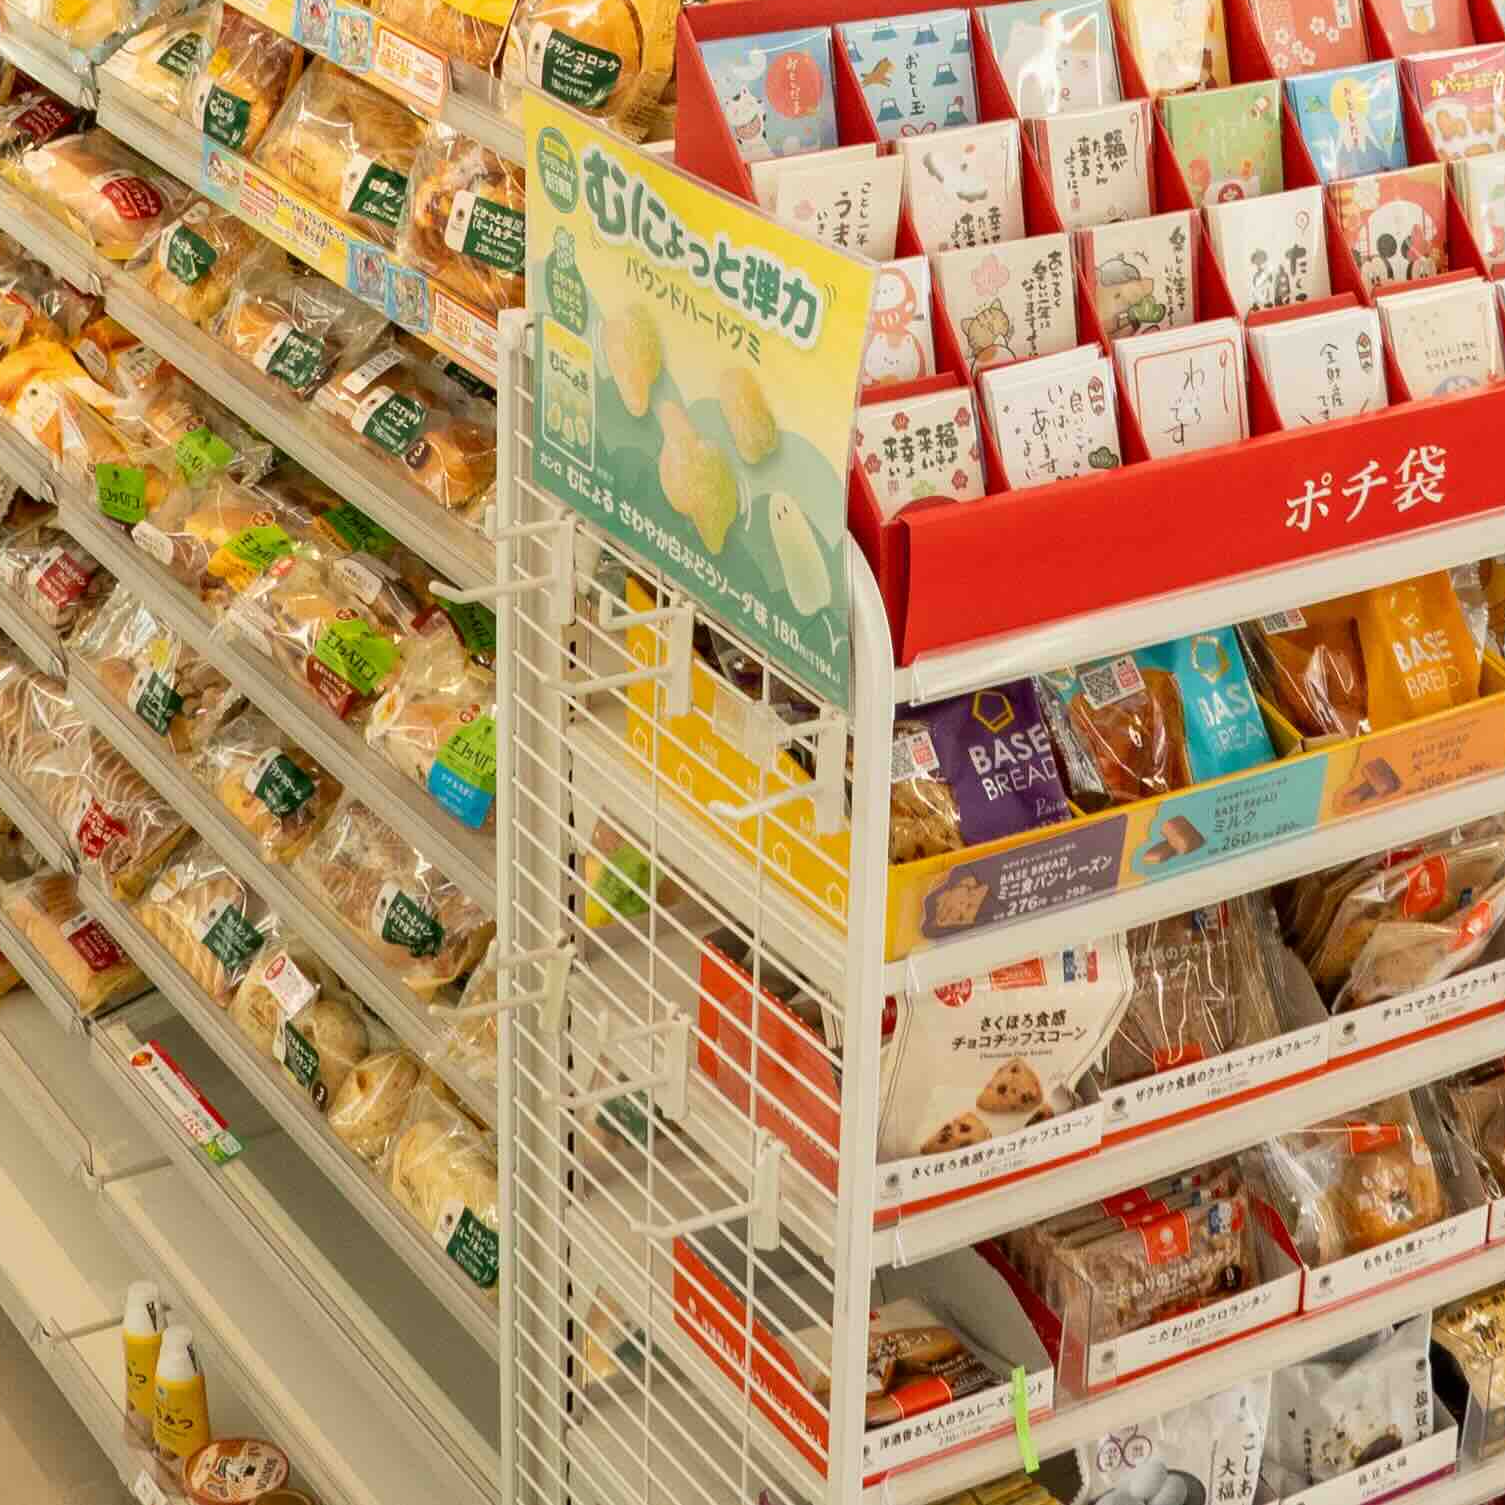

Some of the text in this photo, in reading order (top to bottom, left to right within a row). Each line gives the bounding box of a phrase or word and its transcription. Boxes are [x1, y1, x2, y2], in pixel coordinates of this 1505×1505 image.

[555, 57, 595, 75] バーガー
[904, 51, 927, 115] おとし玉
[583, 150, 817, 338] むにょっと弾力
[567, 468, 614, 513] むにょる
[1285, 445, 1447, 532] ポチ袋
[1391, 630, 1454, 673] BASE
[1198, 682, 1250, 727] BAS
[968, 726, 1051, 773] BASE
[1215, 721, 1266, 752] REA
[981, 756, 1060, 801] BREAD
[1213, 812, 1257, 834] ミルク
[951, 1026, 1087, 1052] チョコチップスコーン
[979, 1009, 1068, 1031] さくほろ食感
[1135, 1034, 1321, 1102] ザクザク食感のクッキー ナッツ&フルーツ
[910, 1113, 1095, 1180] さくほろ食感チョコチップスコーン
[1147, 1289, 1273, 1346] こだわりのフロランタン
[1216, 1459, 1236, 1503] 大福
